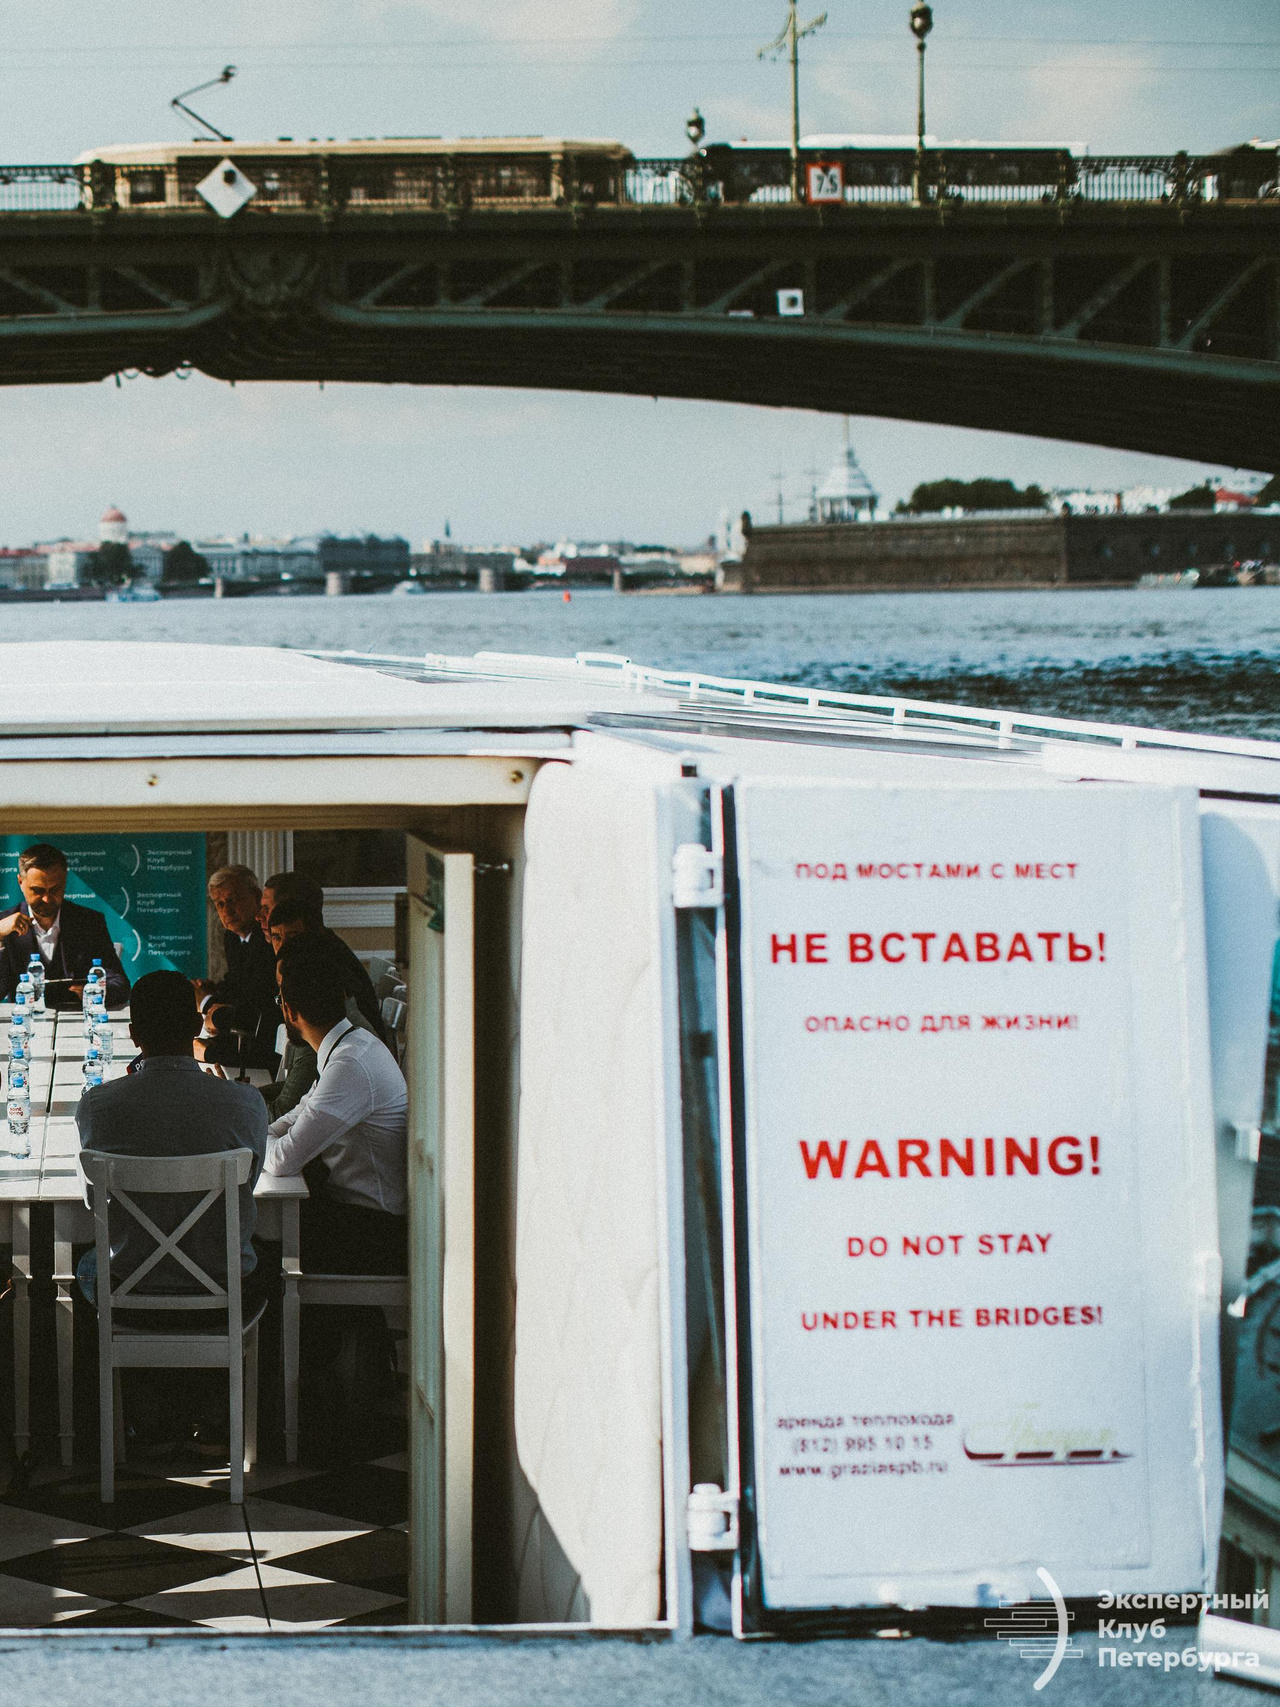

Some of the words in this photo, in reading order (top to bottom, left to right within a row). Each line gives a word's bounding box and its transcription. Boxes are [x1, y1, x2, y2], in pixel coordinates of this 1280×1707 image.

[796, 863, 848, 881] ПОД
[856, 863, 981, 881] МОСТАМИ
[991, 863, 1005, 880] С
[1015, 863, 1079, 880] МЕСТ
[771, 933, 829, 964] НЕ
[849, 932, 1107, 964] ВСТАВАТЬ!
[804, 1015, 911, 1033] ОПАСНО
[920, 1015, 971, 1034] ДЛЯ
[981, 1014, 1080, 1031] ЖИЗНИ!
[799, 1135, 1102, 1181] WARNING!
[847, 1237, 888, 1258] DO
[903, 1235, 965, 1257] NOT
[979, 1233, 1053, 1256] STAY
[801, 1310, 898, 1332] UNDER
[910, 1308, 962, 1329] THE
[975, 1305, 1104, 1328] BRIDGES!
[777, 1416, 844, 1431] аренда
[852, 1414, 955, 1427] теплохода
